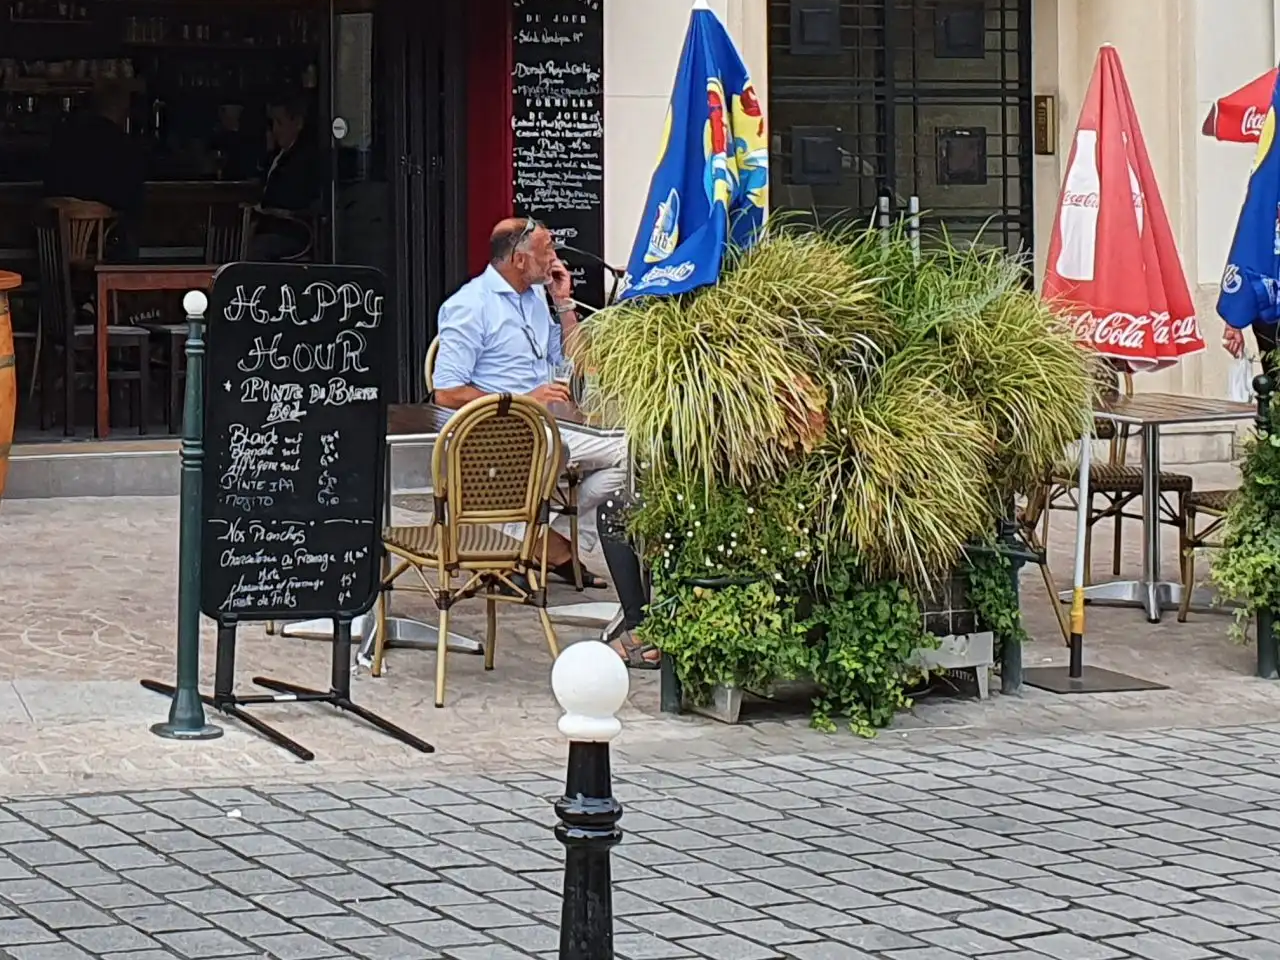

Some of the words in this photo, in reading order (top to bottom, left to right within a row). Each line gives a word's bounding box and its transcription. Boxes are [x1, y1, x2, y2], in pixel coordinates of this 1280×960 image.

[553, 14, 587, 24] JOUR
[224, 281, 384, 328] HAPPY
[237, 329, 369, 373] HOUR
[220, 517, 245, 543] Nos
